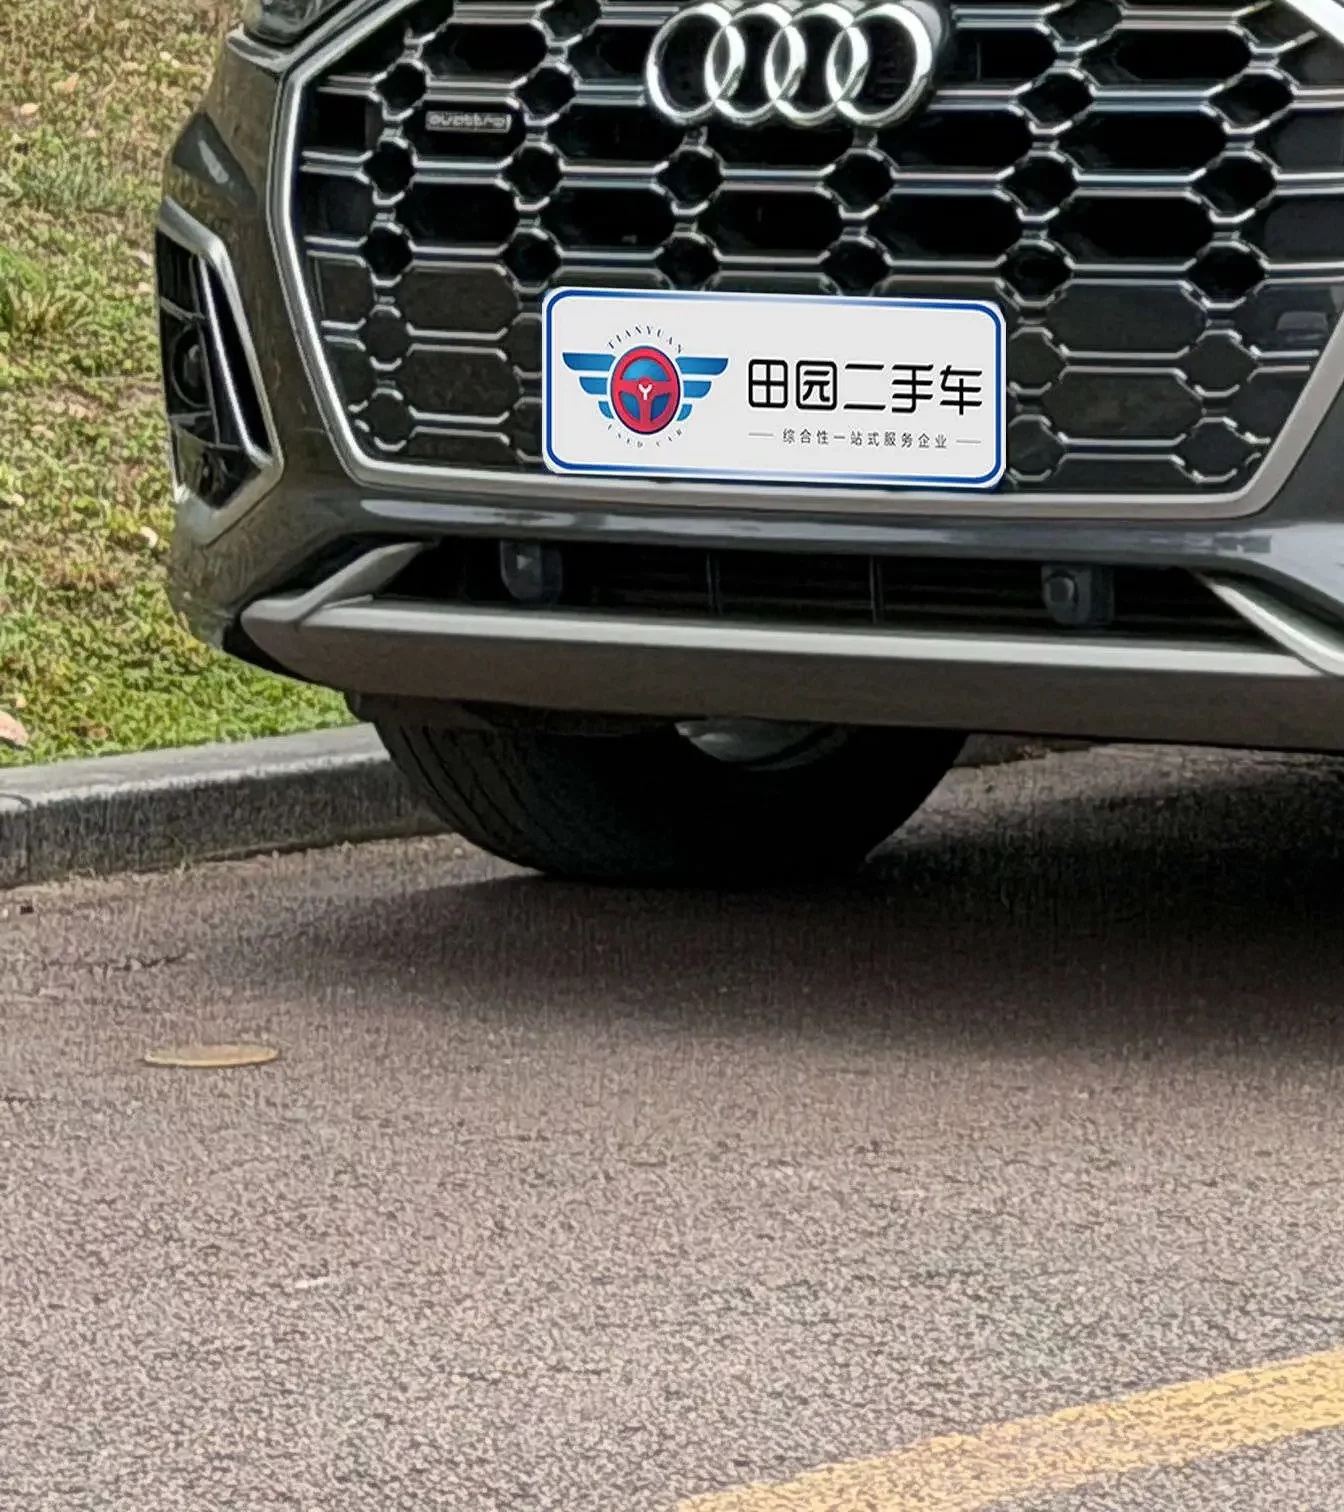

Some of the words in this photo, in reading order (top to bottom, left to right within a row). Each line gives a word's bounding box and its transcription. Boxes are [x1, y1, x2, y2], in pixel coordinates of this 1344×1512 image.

[748, 358, 983, 416] 田园二手车
[782, 428, 947, 449] 综合性一站式服务企业
